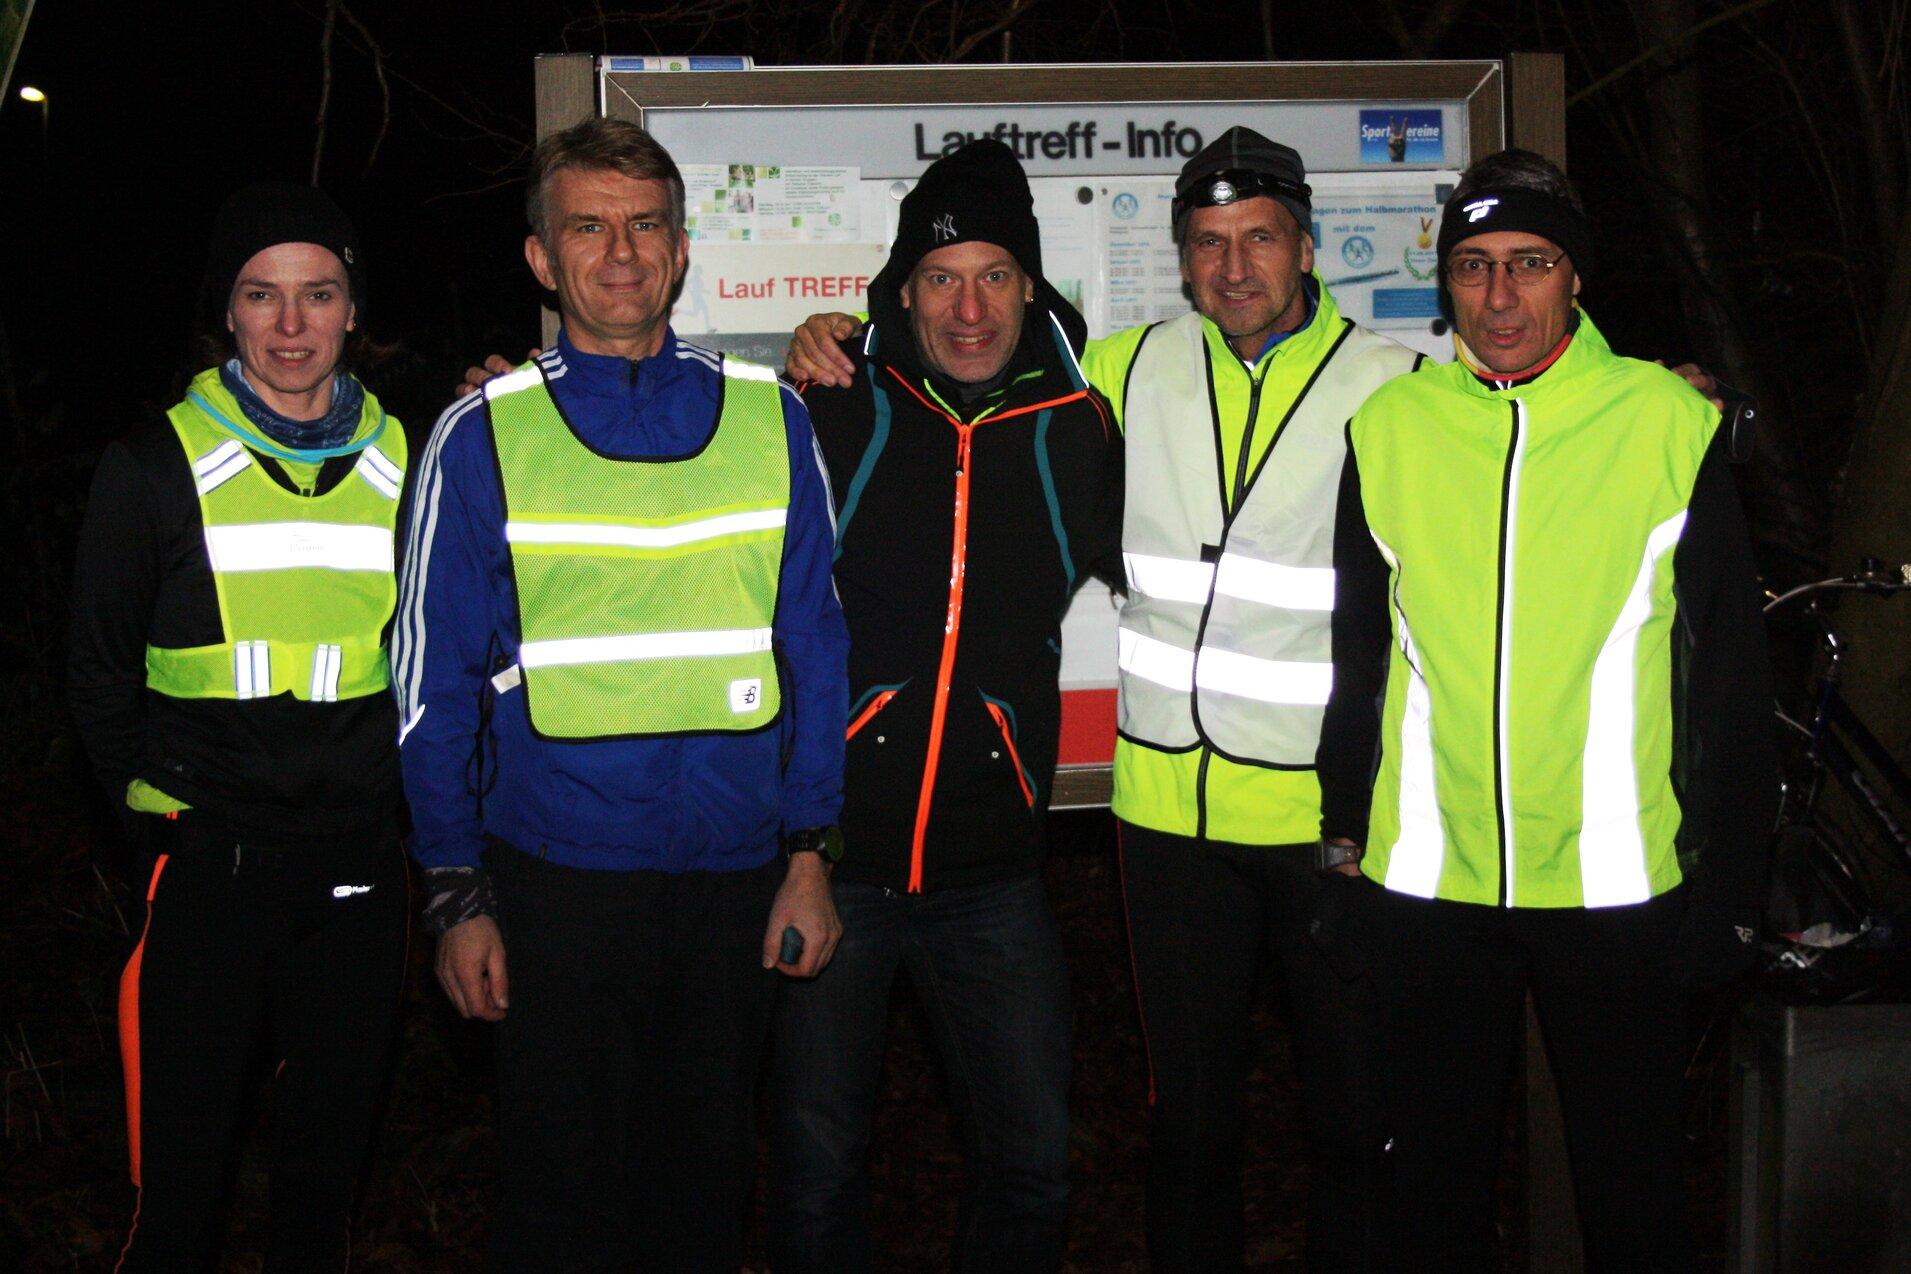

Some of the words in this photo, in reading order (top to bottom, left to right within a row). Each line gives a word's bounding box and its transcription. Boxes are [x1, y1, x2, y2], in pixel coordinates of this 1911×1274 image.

[1361, 124, 1391, 142] Sport
[1340, 207, 1362, 215] zum
[1365, 205, 1436, 214] Halbmarathon
[932, 213, 957, 243] NY
[1332, 225, 1350, 233] mit
[1353, 224, 1375, 232] dem
[719, 277, 775, 299] Lauf
[784, 276, 869, 298] TREFF
